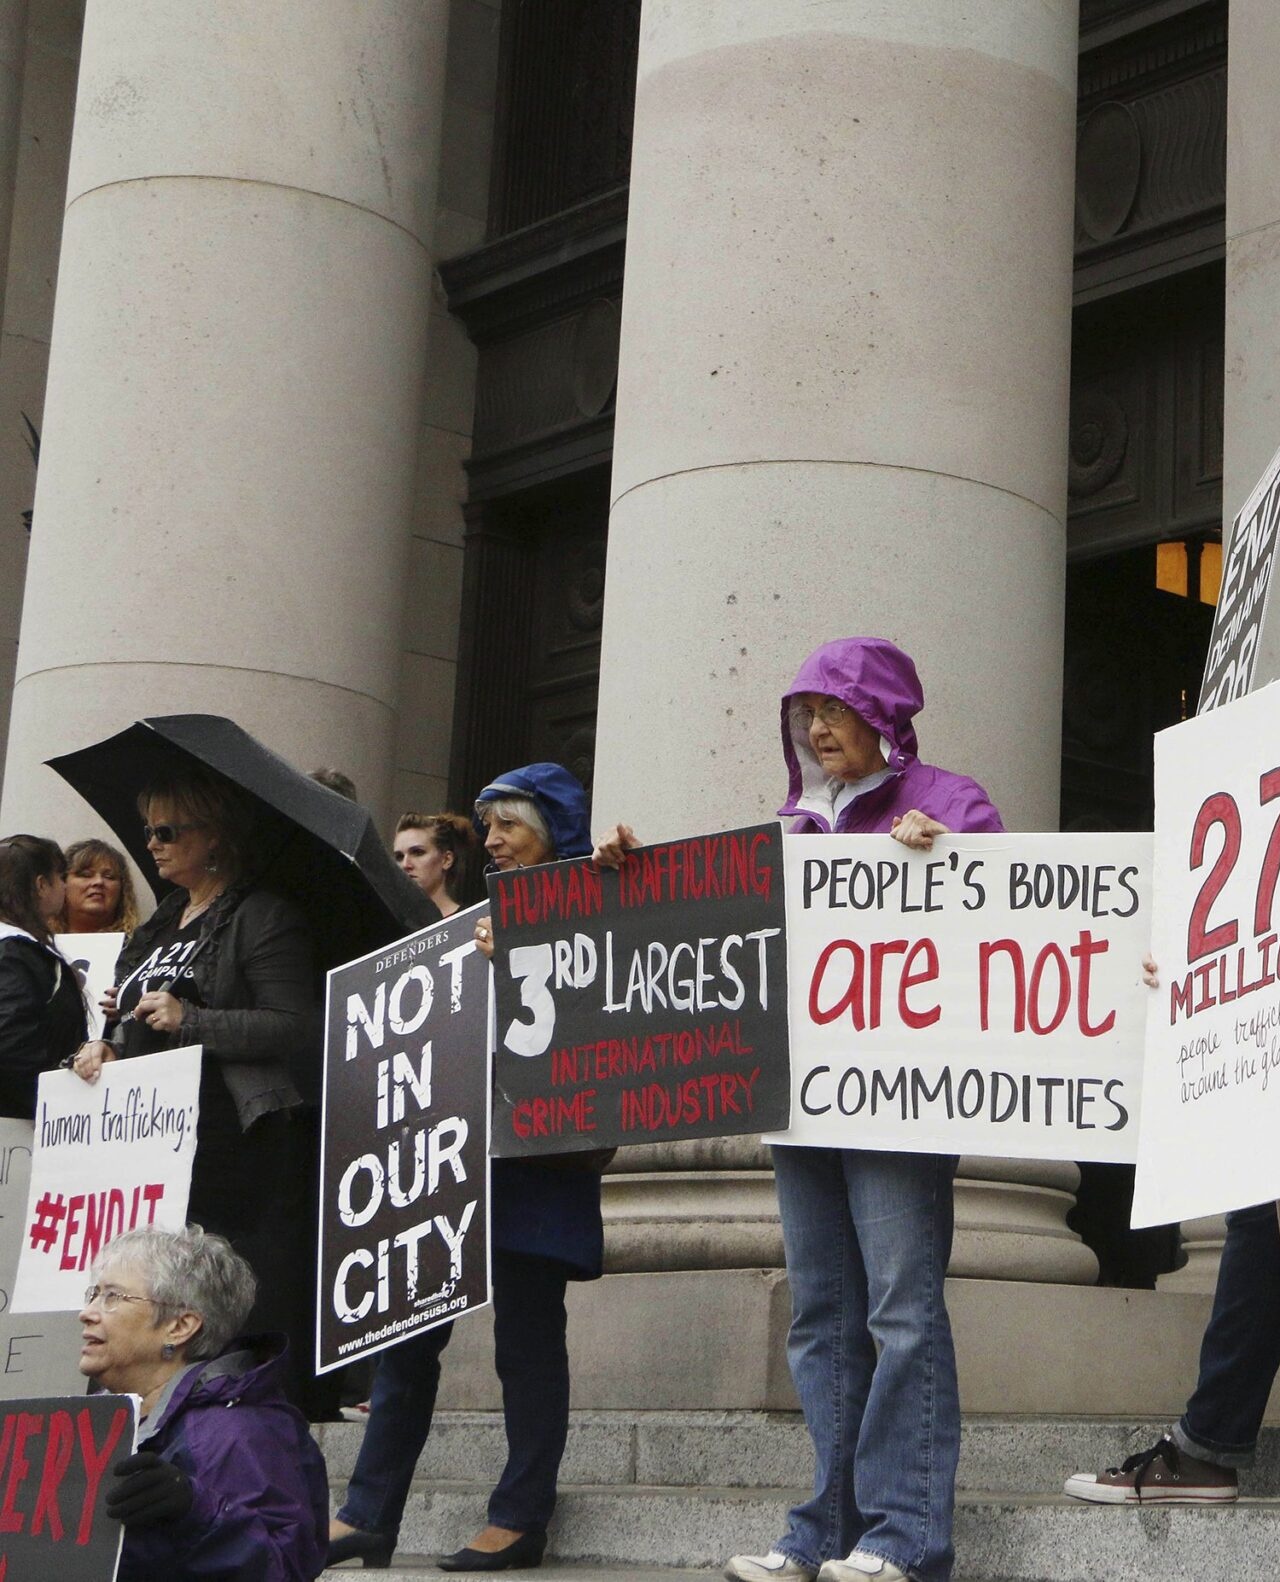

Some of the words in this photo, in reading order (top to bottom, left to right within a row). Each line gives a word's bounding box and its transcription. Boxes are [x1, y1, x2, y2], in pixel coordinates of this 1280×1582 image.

[1207, 552, 1272, 683] DEMAND
[498, 858, 604, 928] HUMAN
[618, 832, 774, 908] TRAFFICKING
[803, 851, 986, 913] PEOPLE'S
[1009, 862, 1140, 918] BODIES
[376, 930, 449, 973] DEFENDERS
[808, 937, 942, 1032] are
[978, 930, 1117, 1038] not
[345, 939, 478, 1062] NOT
[504, 933, 598, 1057] 3RD
[602, 927, 782, 1015] LARGEST
[377, 1040, 432, 1130] IN
[551, 1019, 754, 1086] INTERNATIONAL
[1176, 1029, 1221, 1079] people
[1181, 1062, 1228, 1103] around
[1235, 1056, 1257, 1085] the
[41, 1101, 91, 1148] human
[102, 1086, 193, 1152] trafficking:
[512, 1089, 597, 1139] CRIME
[621, 1067, 761, 1132] INDUSTRY
[800, 1065, 1129, 1131] COMMODITIES
[338, 1116, 469, 1228] OUR
[333, 1200, 478, 1323] CITY
[338, 1294, 468, 1355] www.thedefendersusa.org
